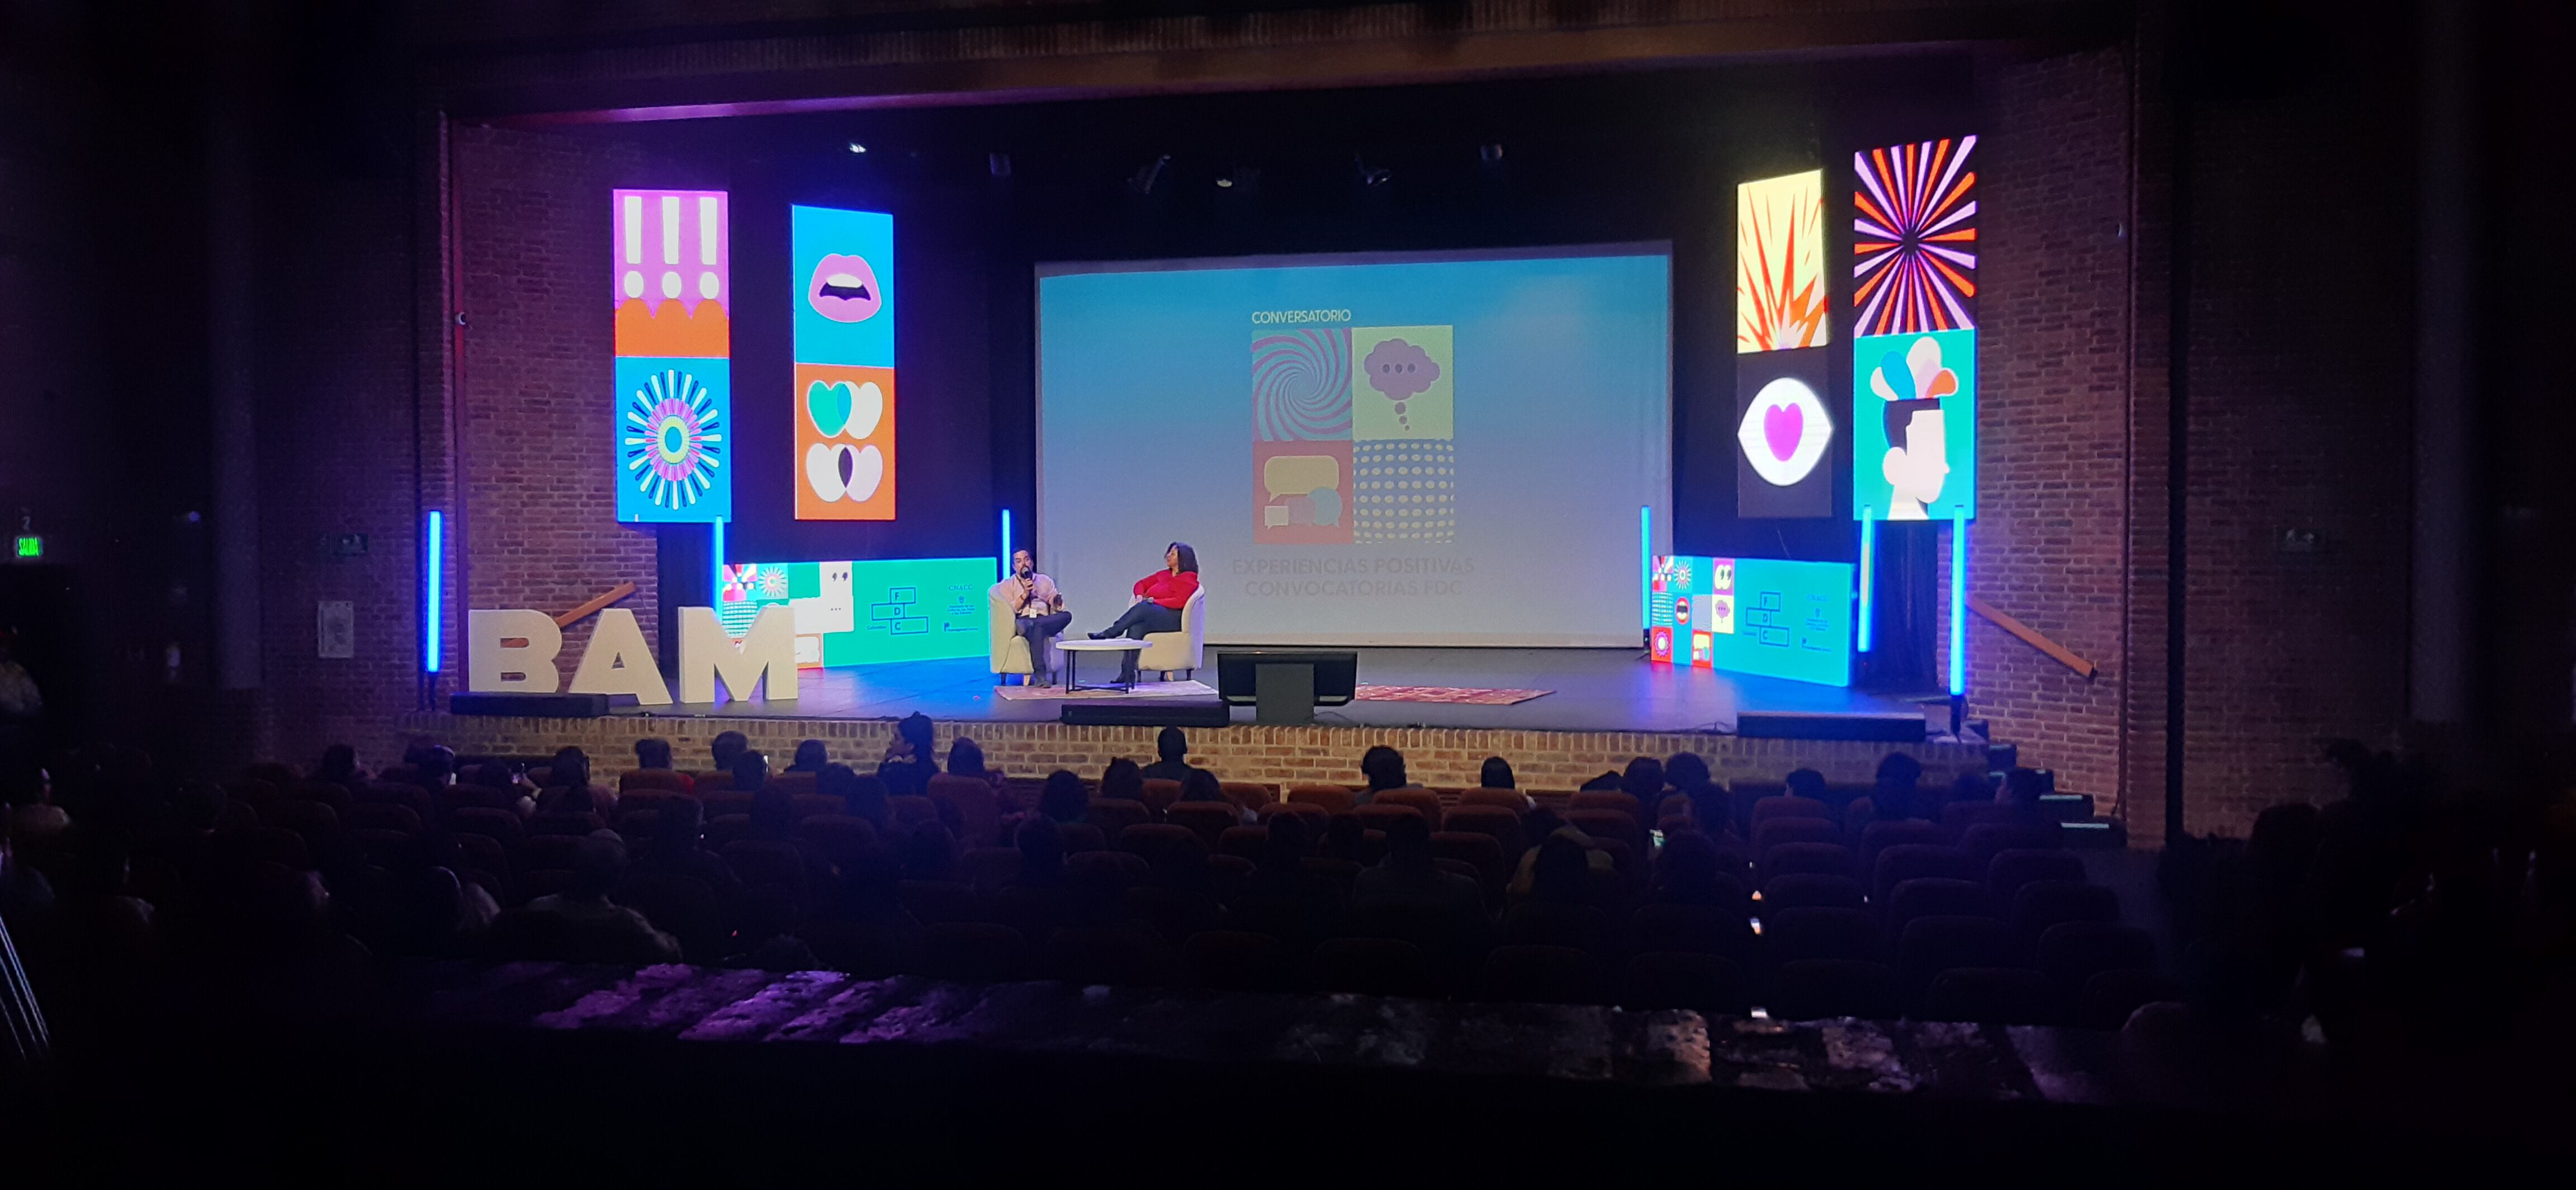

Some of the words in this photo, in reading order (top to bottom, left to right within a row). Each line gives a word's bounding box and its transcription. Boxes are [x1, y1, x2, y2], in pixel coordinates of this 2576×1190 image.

[1252, 309, 1351, 324] CONVERSATORIO
[1233, 559, 1369, 575] EXPERIENCIAS
[1375, 558, 1475, 574] POSITIVAS
[1245, 580, 1418, 597] CONVOCATORIAS
[1424, 580, 1463, 596] FDC
[895, 592, 899, 601] F
[894, 607, 901, 616] D
[1763, 613, 1768, 622] D
[895, 622, 901, 630] C
[1763, 630, 1768, 640] C
[468, 606, 798, 705] BAM
